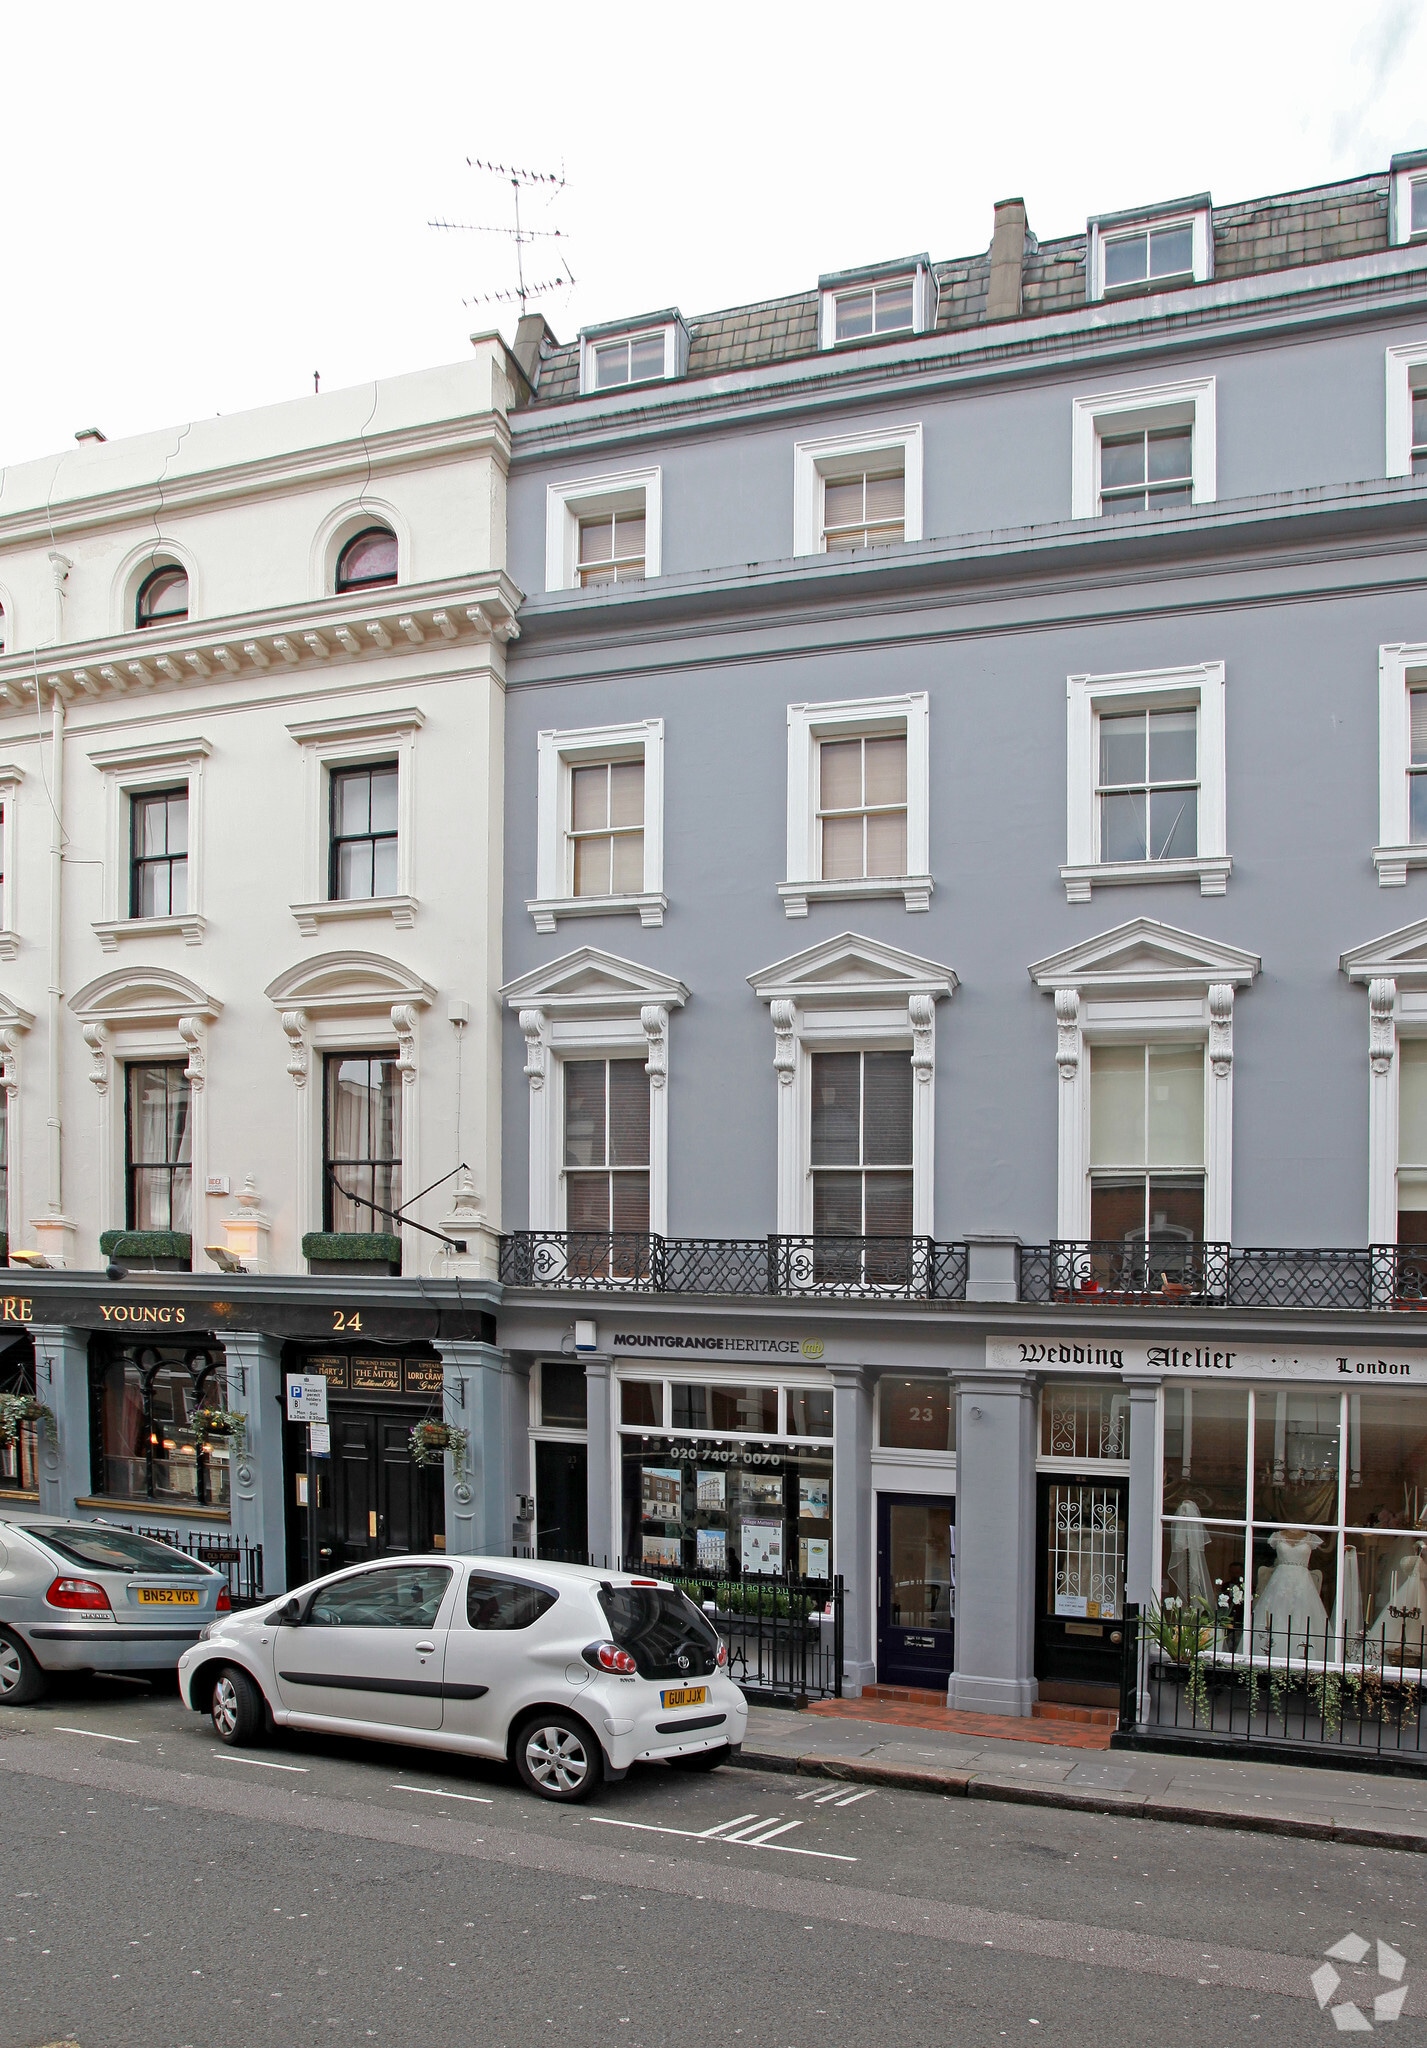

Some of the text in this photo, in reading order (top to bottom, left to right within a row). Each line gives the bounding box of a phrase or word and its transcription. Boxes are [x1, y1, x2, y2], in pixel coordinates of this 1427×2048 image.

[0, 1298, 33, 1321] RE
[99, 1305, 186, 1324] YOUNG'S
[332, 1310, 363, 1332] 24
[355, 1360, 379, 1368] GROUND
[1018, 1343, 1238, 1370] Wedding Atelier
[354, 1369, 398, 1379] THE MITRE
[1335, 1357, 1411, 1375] London
[407, 1371, 444, 1381] LORD CRAVE
[909, 1407, 933, 1421] 23
[670, 1447, 780, 1466] 020 7402 0070
[143, 1590, 195, 1602] BN52 VGX
[686, 1689, 702, 1703] JJX
